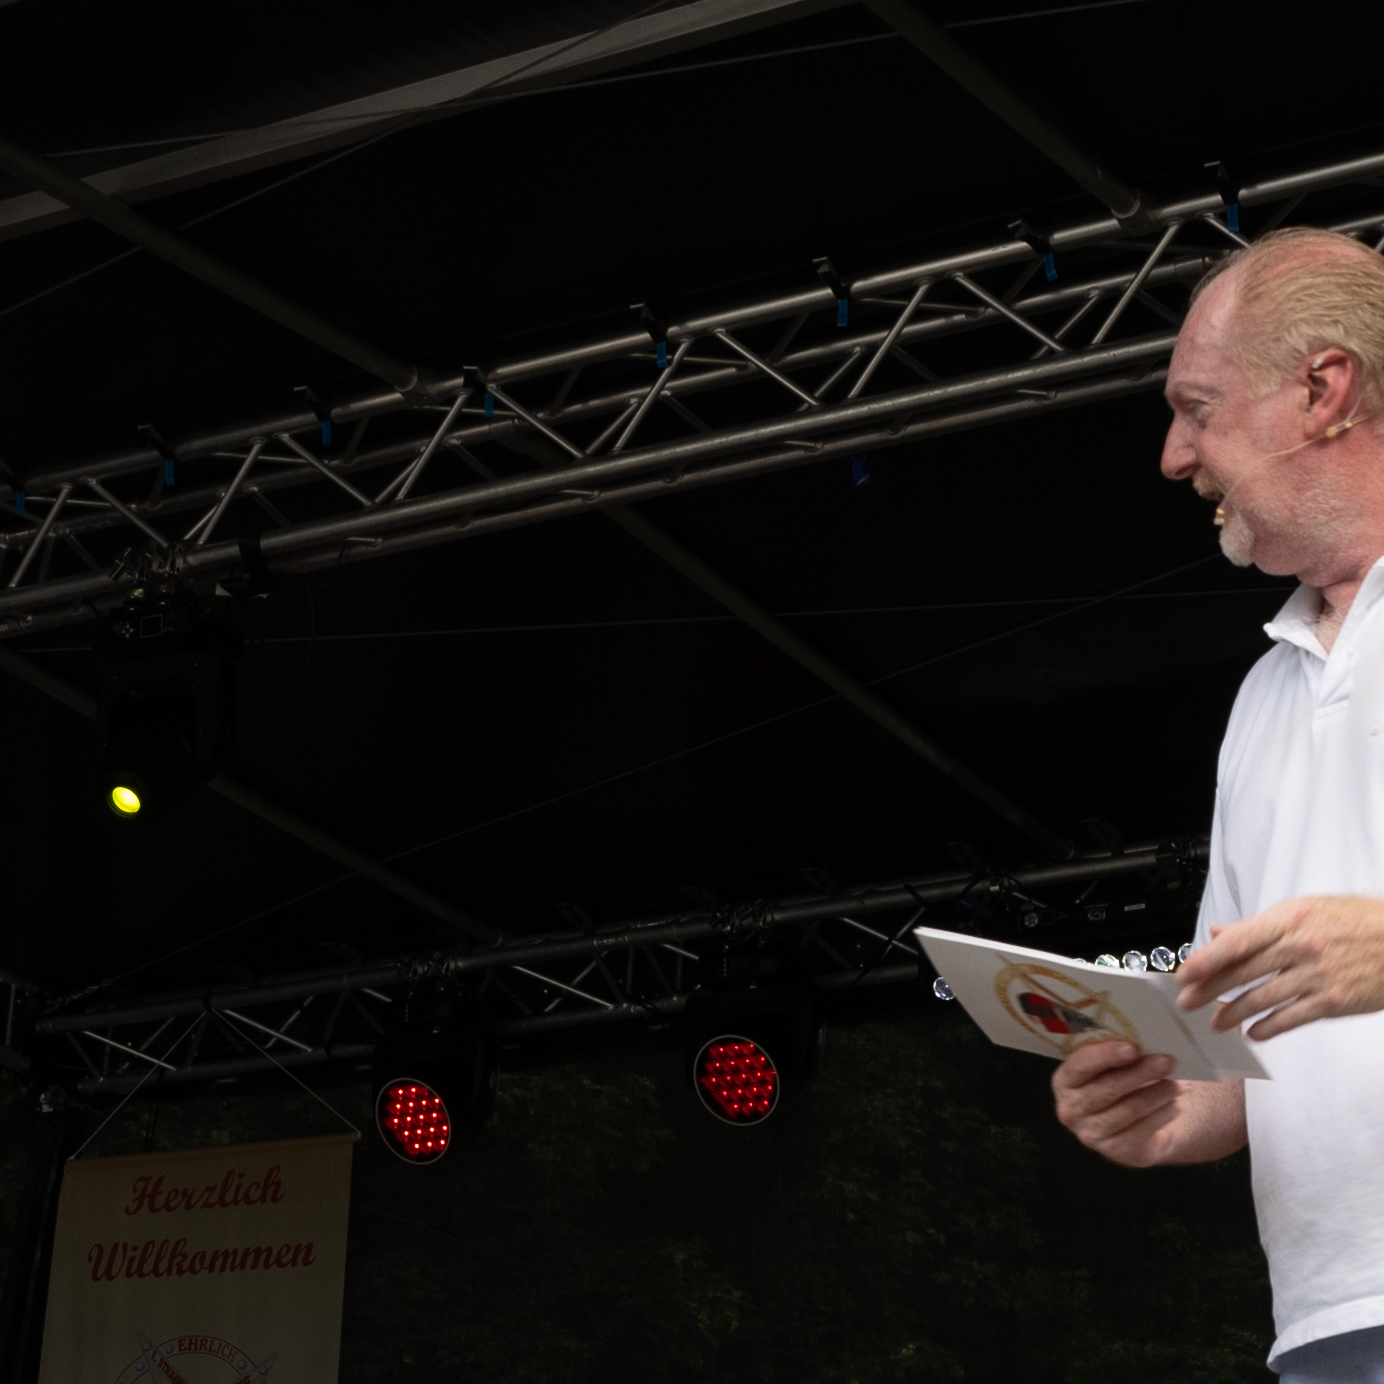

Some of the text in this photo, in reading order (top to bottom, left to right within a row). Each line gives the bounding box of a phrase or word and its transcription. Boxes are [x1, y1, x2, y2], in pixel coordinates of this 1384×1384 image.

[124, 1164, 285, 1215] Herzlich
[87, 1237, 316, 1282] Willkommen
[177, 1338, 238, 1362] EHRLICH
